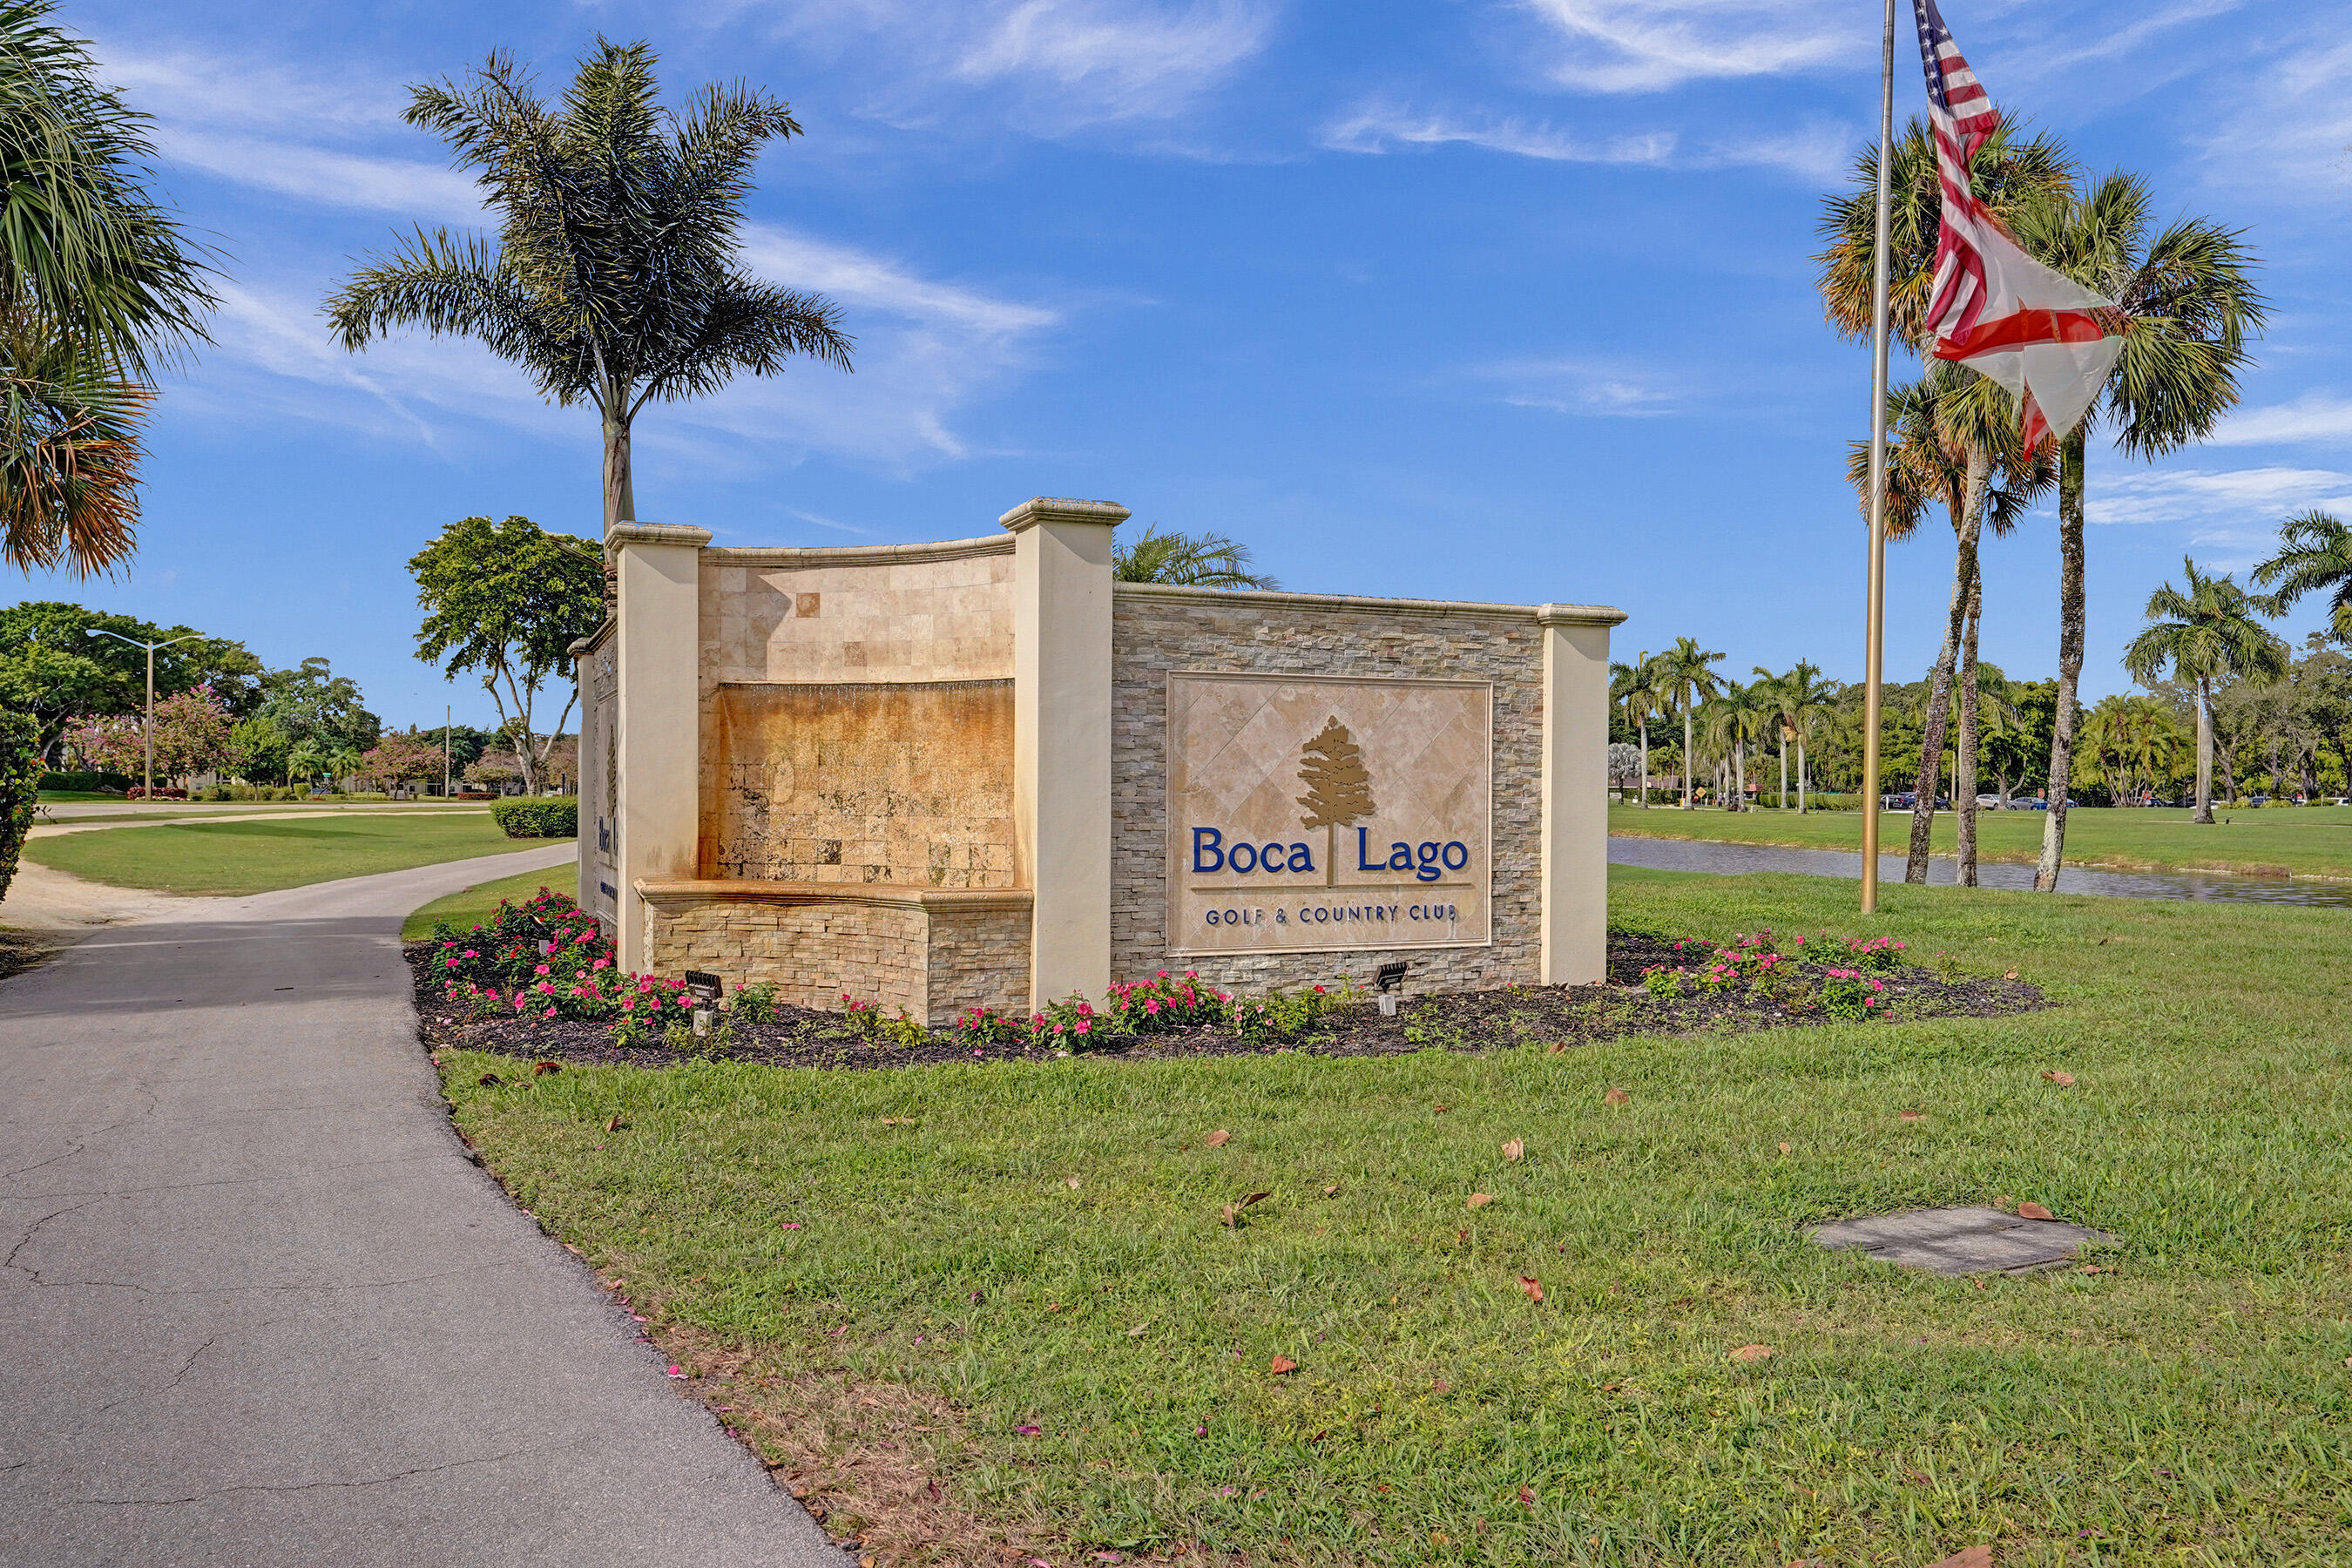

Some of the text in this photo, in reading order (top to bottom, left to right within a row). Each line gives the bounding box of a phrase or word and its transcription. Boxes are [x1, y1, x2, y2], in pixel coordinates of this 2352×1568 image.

[1191, 827, 1469, 882] Boca Lago
[1206, 904, 1456, 925] GOLF & COUNTRY CLUB
